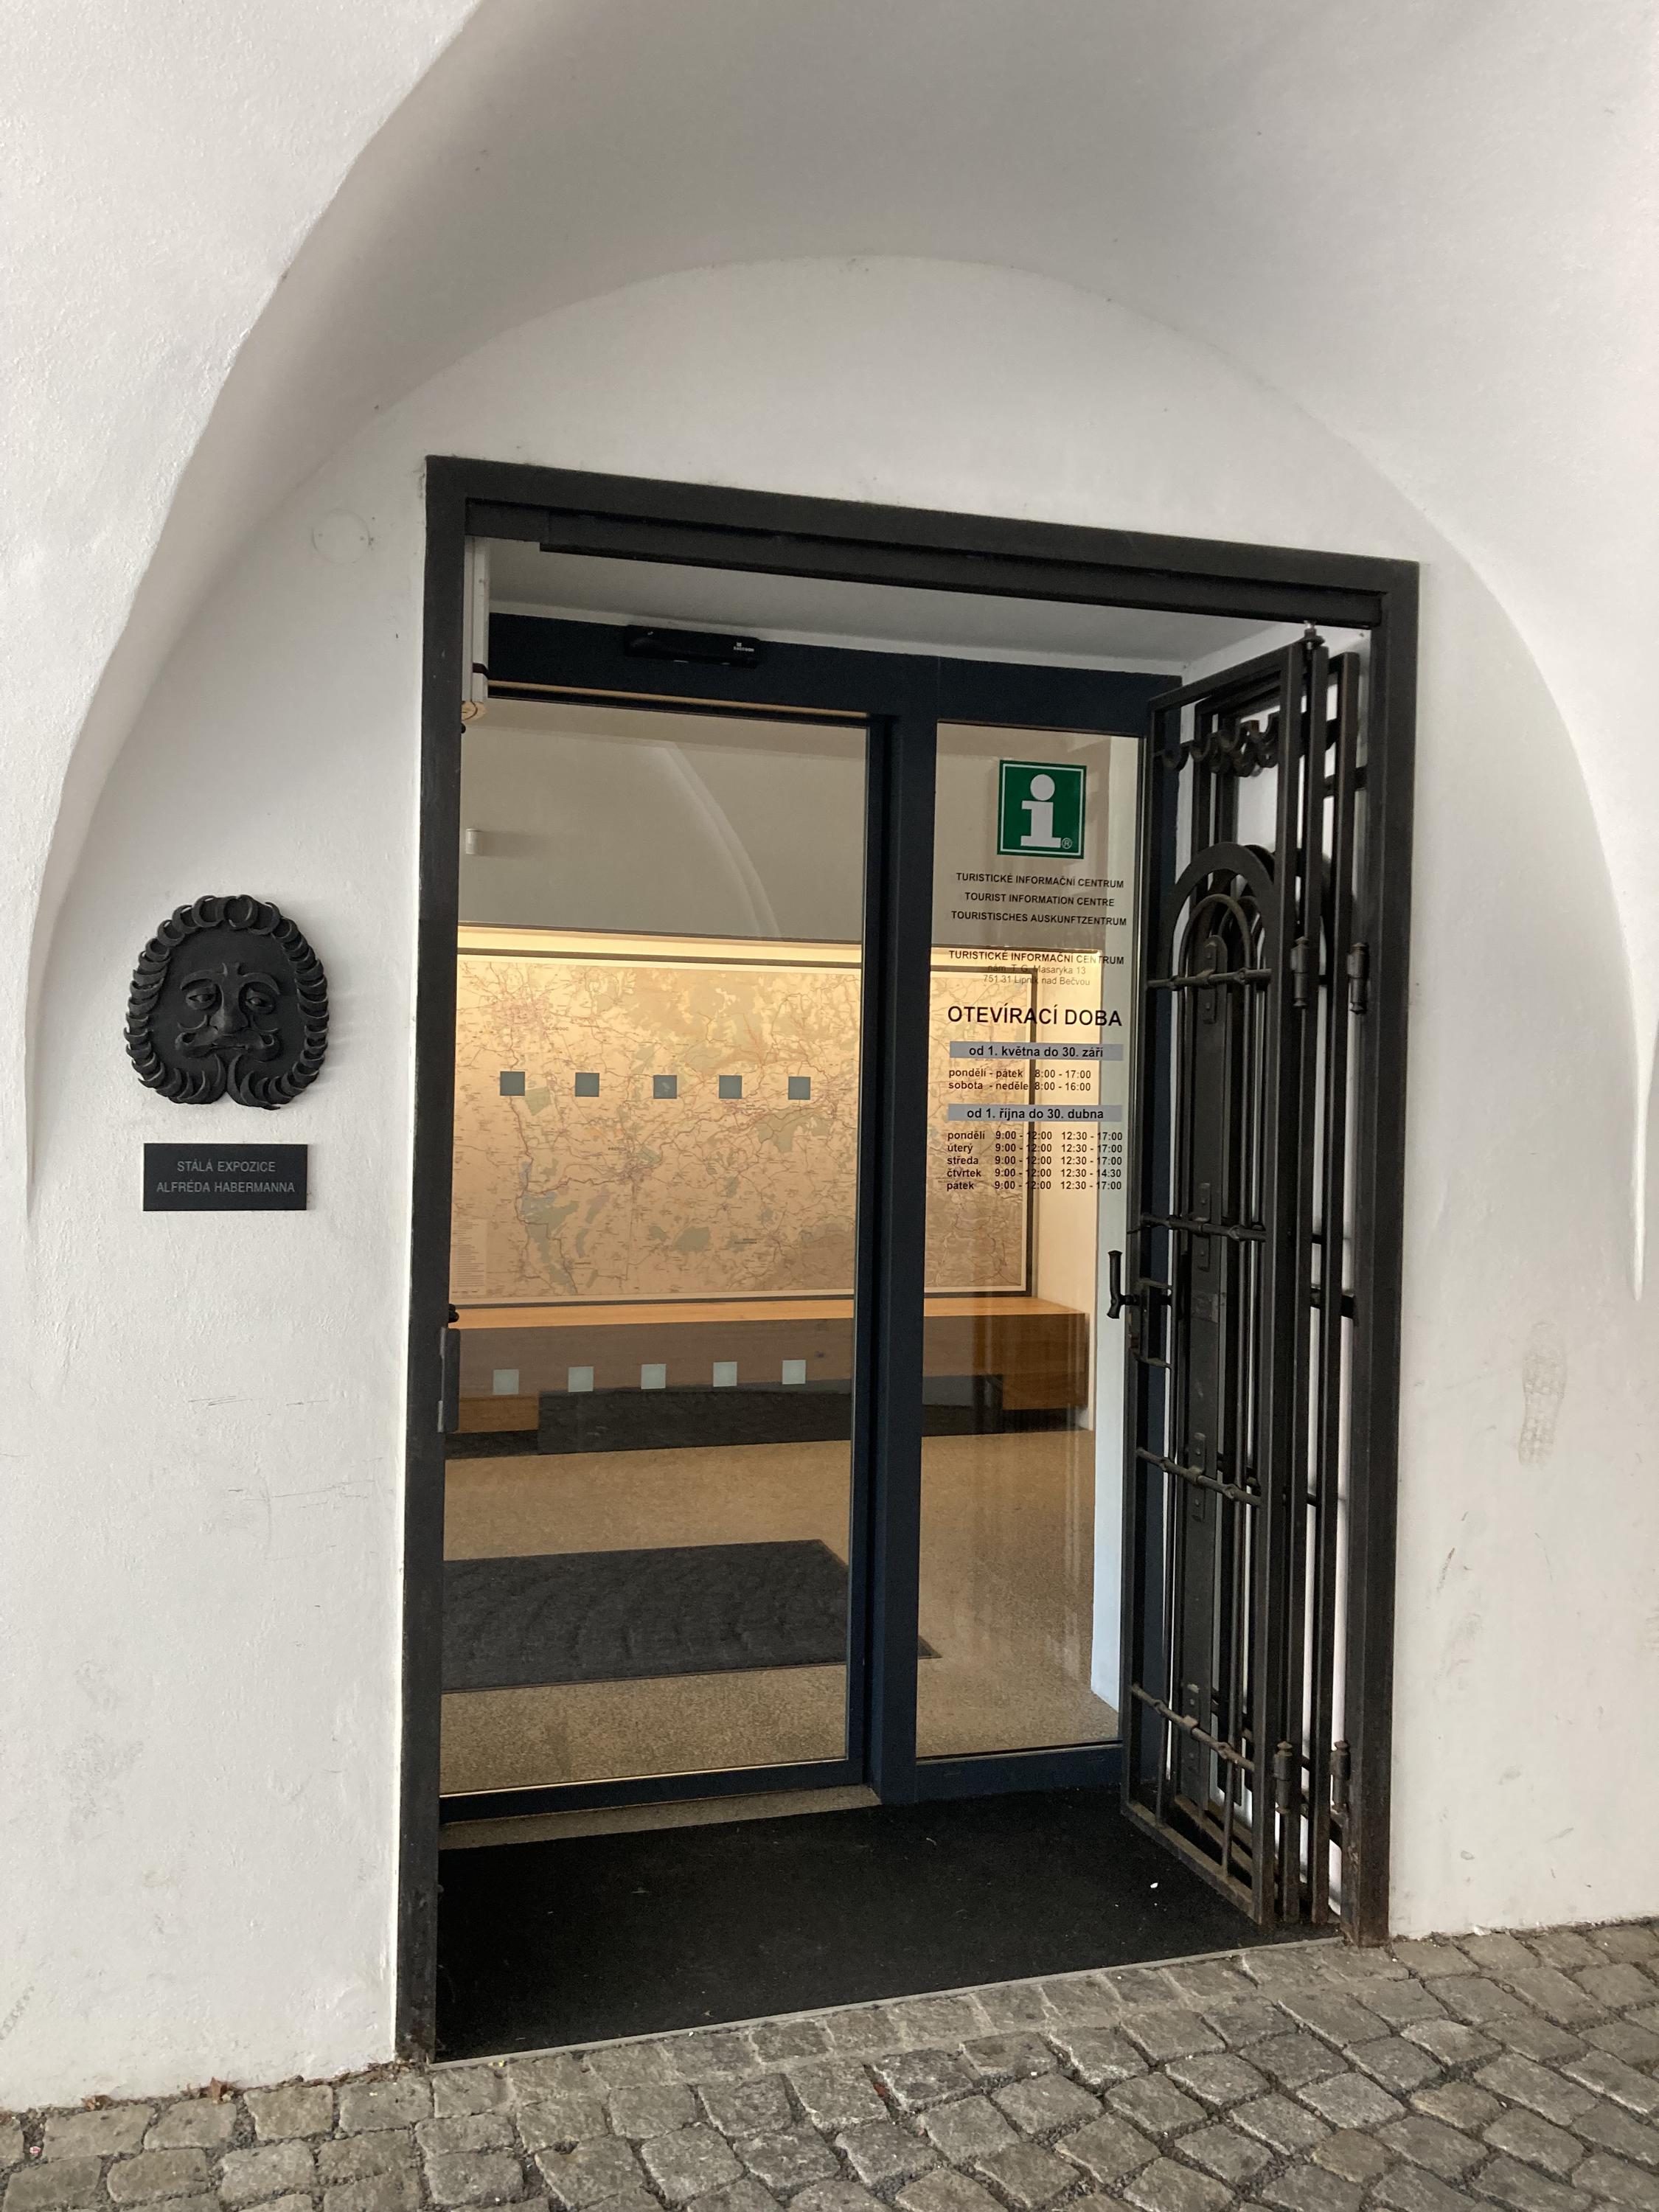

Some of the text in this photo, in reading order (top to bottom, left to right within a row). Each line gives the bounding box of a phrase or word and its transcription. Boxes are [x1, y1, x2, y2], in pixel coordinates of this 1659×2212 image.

[956, 872, 1124, 888] TURISTICKÉ INFORMAČNÍ CENTRUM
[964, 892, 1115, 907] TOURIST INFORMATION CENTRE
[951, 911, 1127, 926] TOURISTISCHES AUSKUNFTZENTRUM
[949, 950, 1124, 965] TURISTICKÉ INFORMAČNÍ CENTRUM
[1033, 965, 1073, 975] Masaryka
[1077, 967, 1086, 975] 13
[984, 974, 998, 983] 751
[1001, 975, 1012, 983] 31
[1042, 977, 1057, 985] nad
[1060, 976, 1091, 986] Bečvou
[947, 1002, 1123, 1026] OTEVÍRACÍ DOBA
[969, 1046, 1104, 1057] od 1. května do 30. září
[949, 1068, 987, 1079] pondělí
[995, 1068, 1023, 1079] pátek
[1034, 1070, 1056, 1079] 8:00
[1065, 1070, 1091, 1079] 17:00
[948, 1081, 984, 1090] sobota
[995, 1081, 1029, 1091] neděle
[1034, 1082, 1056, 1091] 8:00
[1065, 1082, 1091, 1091] 16:00
[967, 1107, 1104, 1121] od 1. října do 30. dubna
[947, 1131, 985, 1141] pondělí
[995, 1131, 1017, 1140] 9:00
[1026, 1131, 1052, 1140] 12:00
[1062, 1131, 1088, 1140] 12:30
[1097, 1132, 1123, 1141] 17:00
[947, 1143, 973, 1155] úterý
[995, 1144, 1017, 1152] 9:00
[1026, 1144, 1052, 1152] 12:00
[1062, 1144, 1088, 1152] 12:30
[1097, 1144, 1122, 1153] 17:00
[177, 1158, 276, 1172] STÁLÁ EXPOZICE
[947, 1155, 978, 1165] středa
[995, 1155, 1016, 1164] 9:00
[1026, 1156, 1052, 1165] 12:00
[1061, 1156, 1087, 1165] 12:30
[1097, 1156, 1122, 1165] 17:00
[947, 1168, 981, 1178] čtvrtek
[995, 1168, 1016, 1177] 9:00
[1026, 1168, 1051, 1178] 12:00
[1061, 1169, 1087, 1178] 12:30
[1096, 1169, 1121, 1178] 14:30
[215, 1181, 296, 1193] HABERMANNA
[947, 1180, 974, 1192] pátek
[995, 1180, 1015, 1189] 9:00
[1026, 1180, 1051, 1189] 12:00
[1061, 1181, 1087, 1189] 12:30
[1096, 1181, 1121, 1190] 17:00
